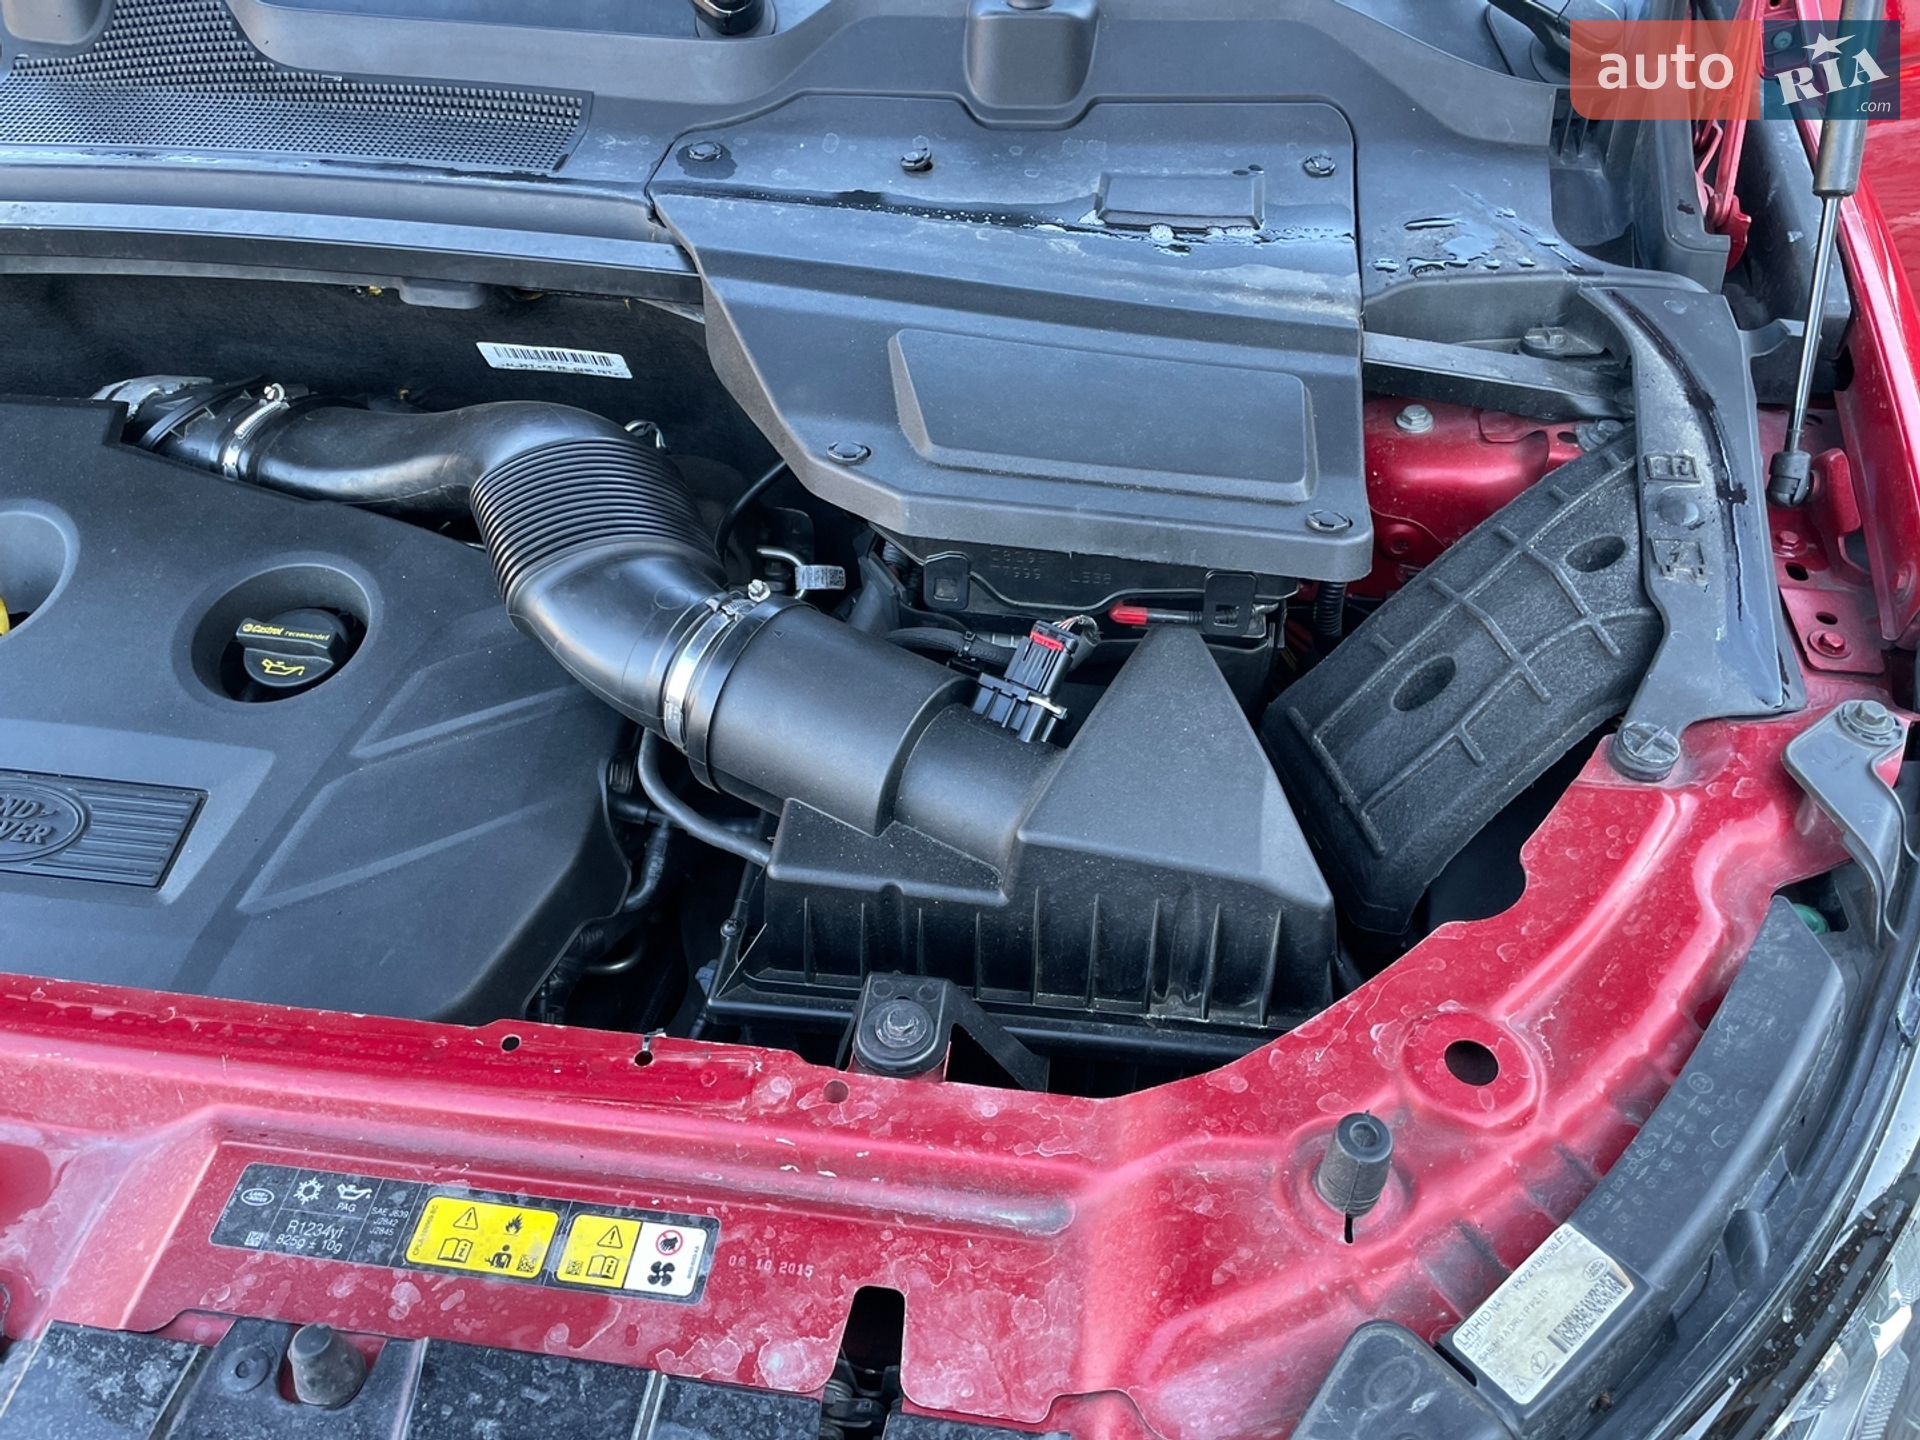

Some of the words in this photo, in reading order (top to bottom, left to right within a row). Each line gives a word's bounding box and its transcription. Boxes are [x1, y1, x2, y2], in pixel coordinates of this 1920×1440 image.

[252, 624, 284, 636] Castrol
[336, 1201, 356, 1213] PAG
[371, 1207, 388, 1216] SAE
[286, 1219, 344, 1239] R1234yf
[275, 1234, 306, 1248] 825g
[321, 1241, 343, 1254] 10g
[780, 1261, 815, 1277] 2015
[1456, 1327, 1475, 1346] LH
[1472, 1310, 1492, 1331] HID
